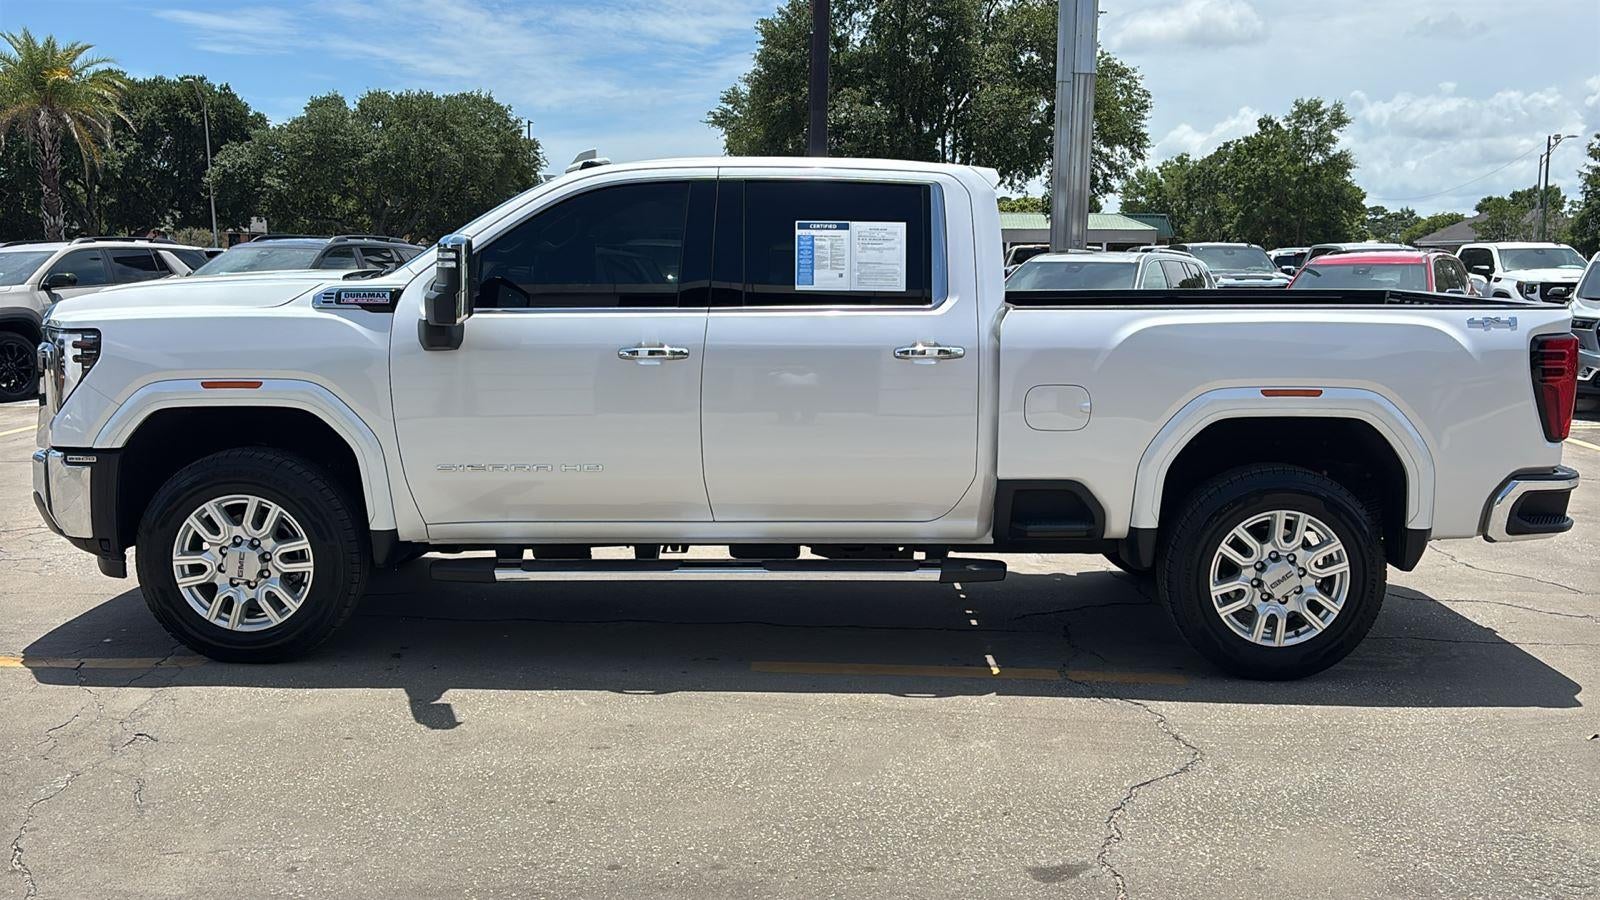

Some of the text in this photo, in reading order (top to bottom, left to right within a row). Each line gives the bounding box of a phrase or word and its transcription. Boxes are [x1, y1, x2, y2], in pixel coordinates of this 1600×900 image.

[436, 463, 604, 472] SIERRA HD
[237, 551, 246, 578] GMC
[1270, 570, 1294, 589] GMC
